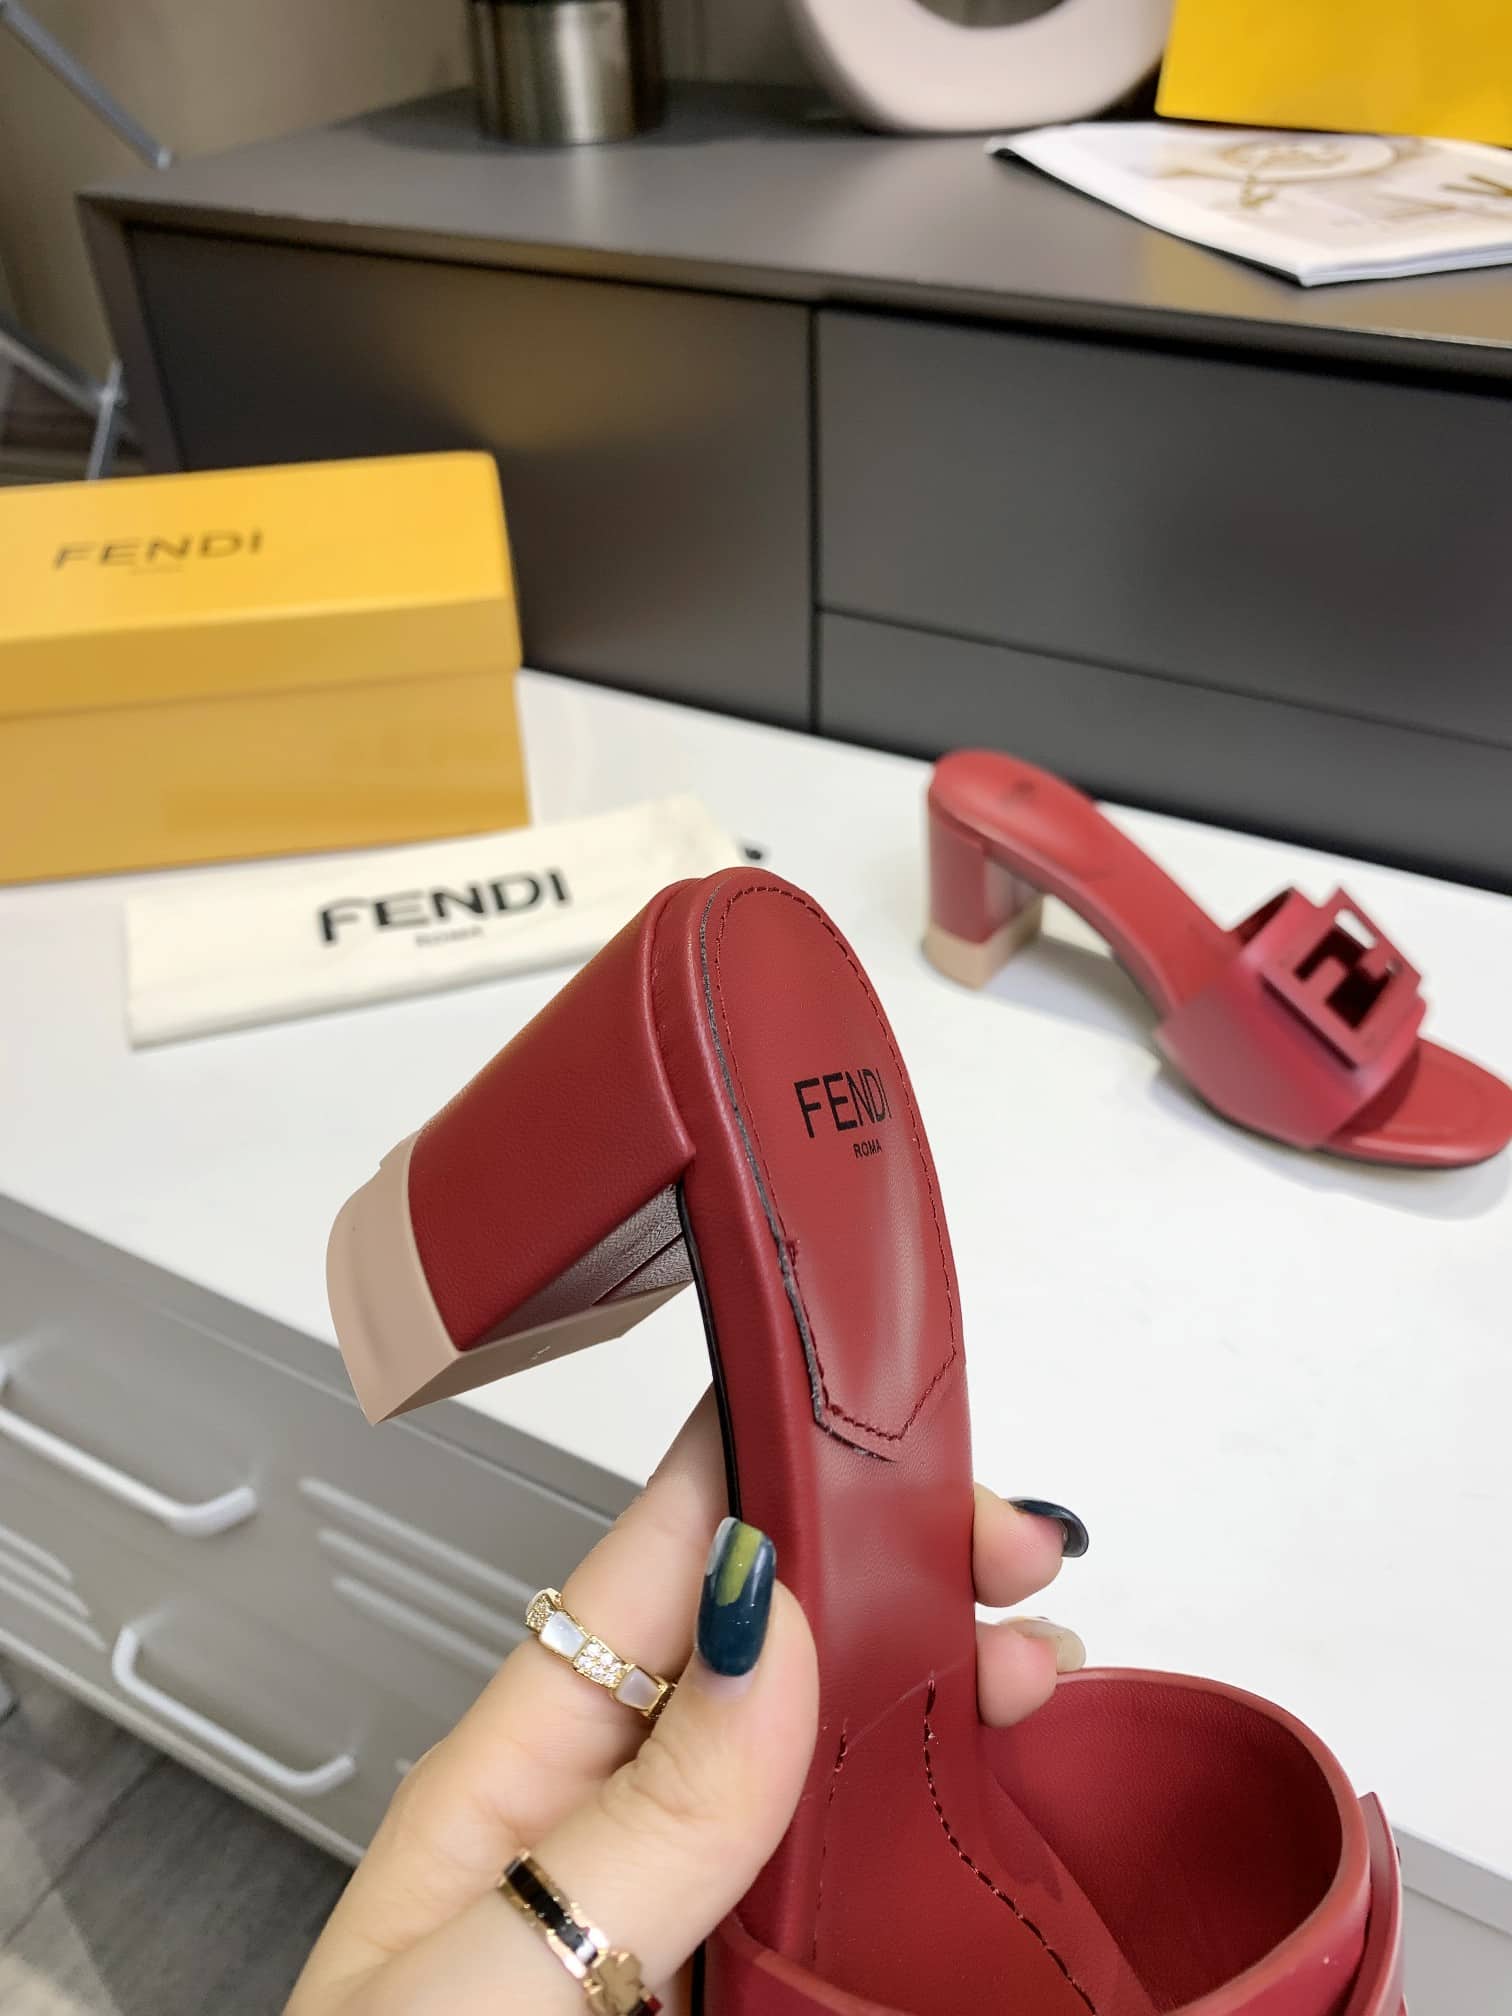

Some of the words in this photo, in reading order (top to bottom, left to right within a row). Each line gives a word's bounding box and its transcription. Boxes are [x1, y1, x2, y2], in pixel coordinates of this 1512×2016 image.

[54, 528, 263, 570] FENDI
[317, 867, 570, 945] FENDI
[794, 1067, 892, 1138] FENDI
[853, 1138, 882, 1159] ROMA
